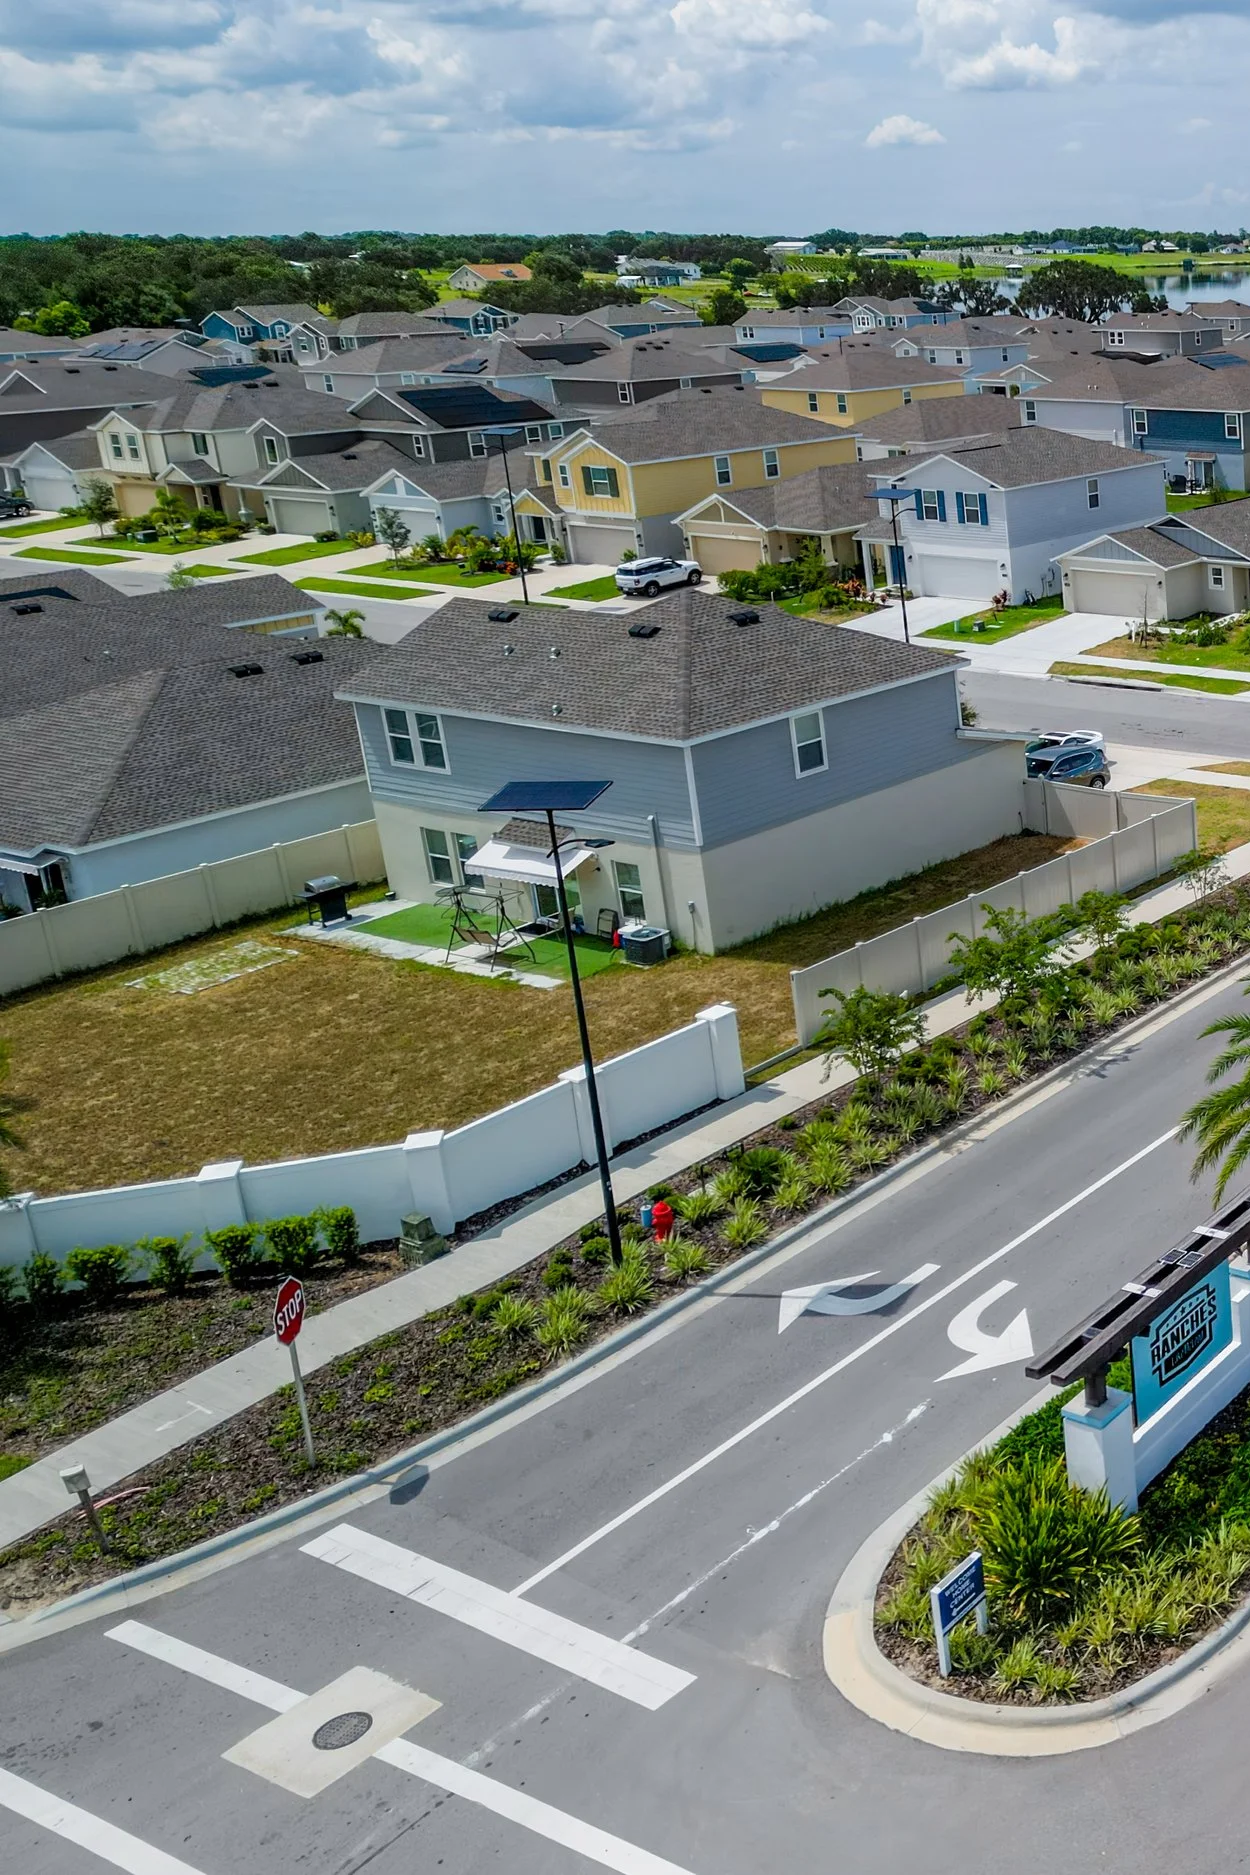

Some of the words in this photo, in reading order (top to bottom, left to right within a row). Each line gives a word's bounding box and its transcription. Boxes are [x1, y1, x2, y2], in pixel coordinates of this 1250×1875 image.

[277, 1289, 301, 1336] STOP
[1151, 1295, 1217, 1368] RANCHES
[945, 1565, 976, 1596] WELCOME
[949, 1582, 975, 1608] CENTER
[952, 1578, 971, 1599] HOME
